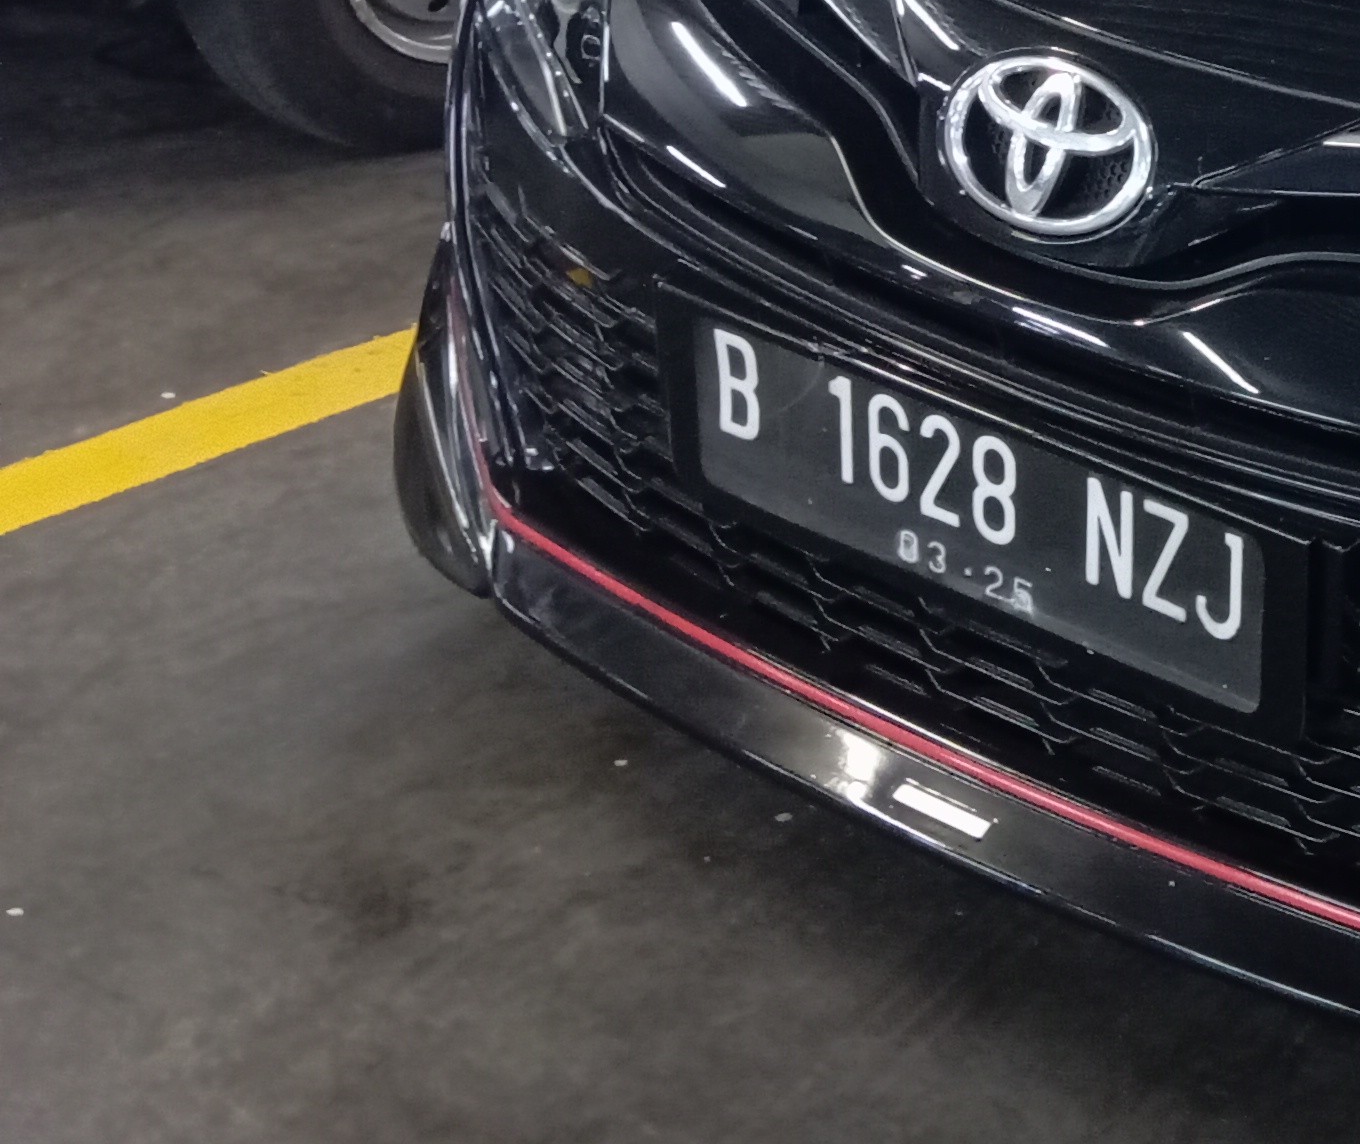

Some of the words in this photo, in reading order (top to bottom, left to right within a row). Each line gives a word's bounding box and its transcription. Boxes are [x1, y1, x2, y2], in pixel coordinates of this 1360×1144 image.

[713, 328, 760, 440] B
[828, 376, 1017, 545] 1628
[1086, 476, 1244, 640] NZJ
